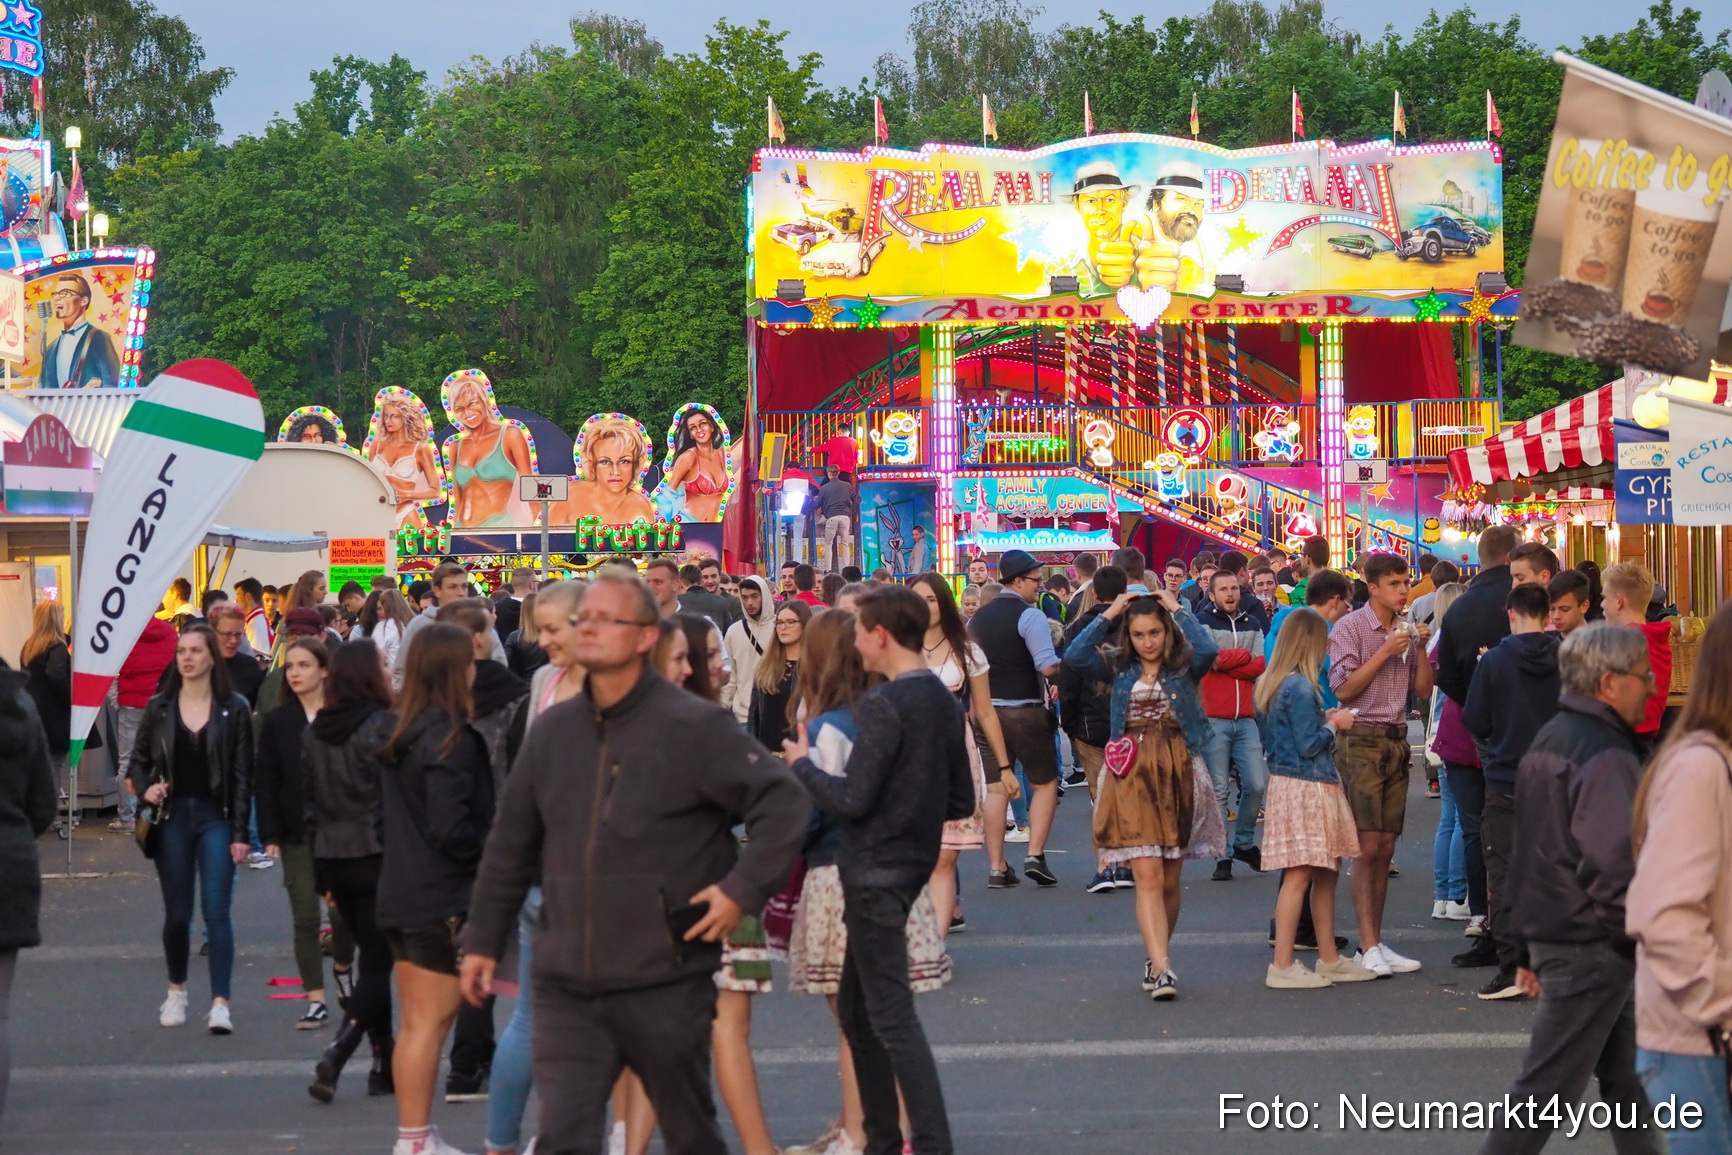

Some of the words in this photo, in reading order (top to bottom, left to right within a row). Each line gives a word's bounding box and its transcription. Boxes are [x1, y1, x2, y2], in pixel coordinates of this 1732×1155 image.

[1553, 137, 1656, 190] Coffee
[1664, 143, 1698, 191] to
[1703, 153, 1732, 206] g
[859, 168, 1054, 259] REMMI
[1204, 162, 1403, 259] DEMMI
[1579, 190, 1630, 212] Coffee
[1585, 208, 1602, 222] to
[1606, 215, 1625, 228] go
[1644, 220, 1702, 242] Coffee
[1650, 243, 1669, 256] to
[1674, 248, 1696, 262] go
[923, 298, 1104, 320] ACTION
[1190, 295, 1371, 318] CENTER
[25, 420, 73, 464] LANGOS
[1619, 444, 1671, 459] RESTAURAN
[1677, 437, 1732, 469] RESTA
[996, 477, 1047, 494] FAMILY
[996, 494, 1048, 511] ACTION
[1057, 493, 1107, 510] CENTER
[1257, 484, 1309, 514] FUN
[1680, 502, 1732, 513] GRIECHISCH
[576, 514, 682, 551] Frutti
[90, 453, 178, 655] LANGOS
[331, 548, 384, 558] Hochfeuerwerk
